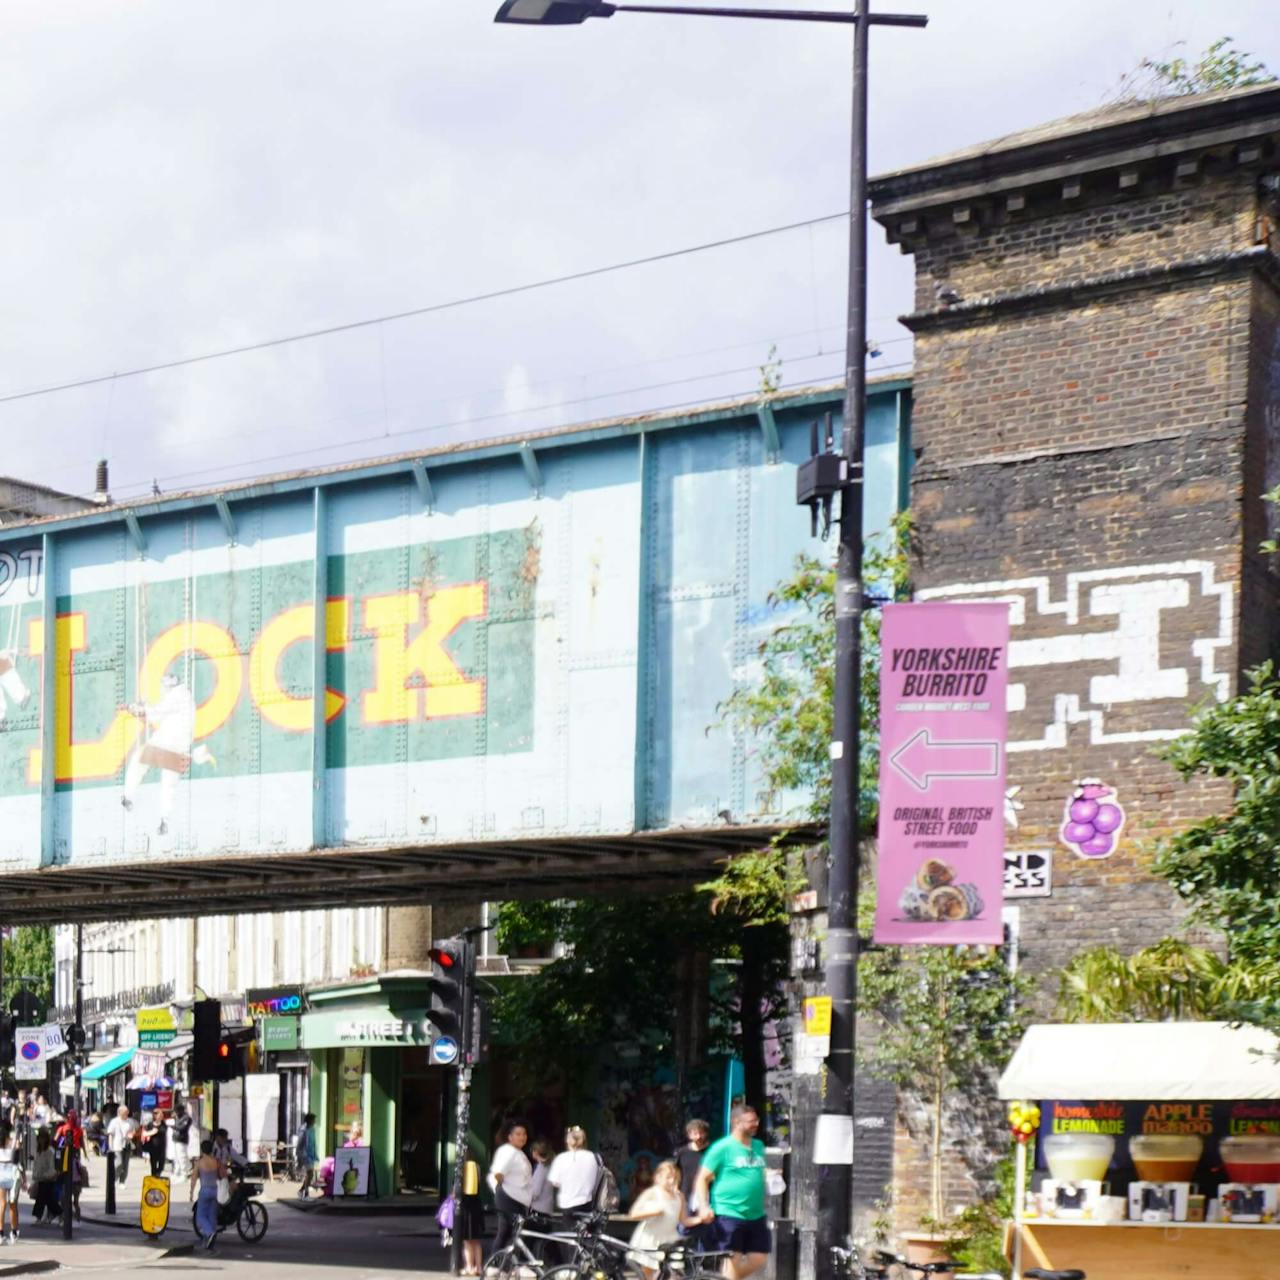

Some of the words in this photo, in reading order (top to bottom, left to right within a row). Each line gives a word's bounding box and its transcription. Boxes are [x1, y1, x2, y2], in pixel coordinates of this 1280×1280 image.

[891, 647, 1002, 672] YORKSHIRE
[28, 580, 488, 785] LOCK
[902, 673, 988, 697] BURRITO
[893, 808, 944, 821] ORIGINAL
[948, 807, 993, 821] BRITISH
[904, 822, 945, 836] STREET
[947, 822, 978, 836] FOOD
[249, 995, 301, 1015] TATTOO
[1143, 1103, 1214, 1121] APPLE
[1052, 1118, 1125, 1135] LEMONADE
